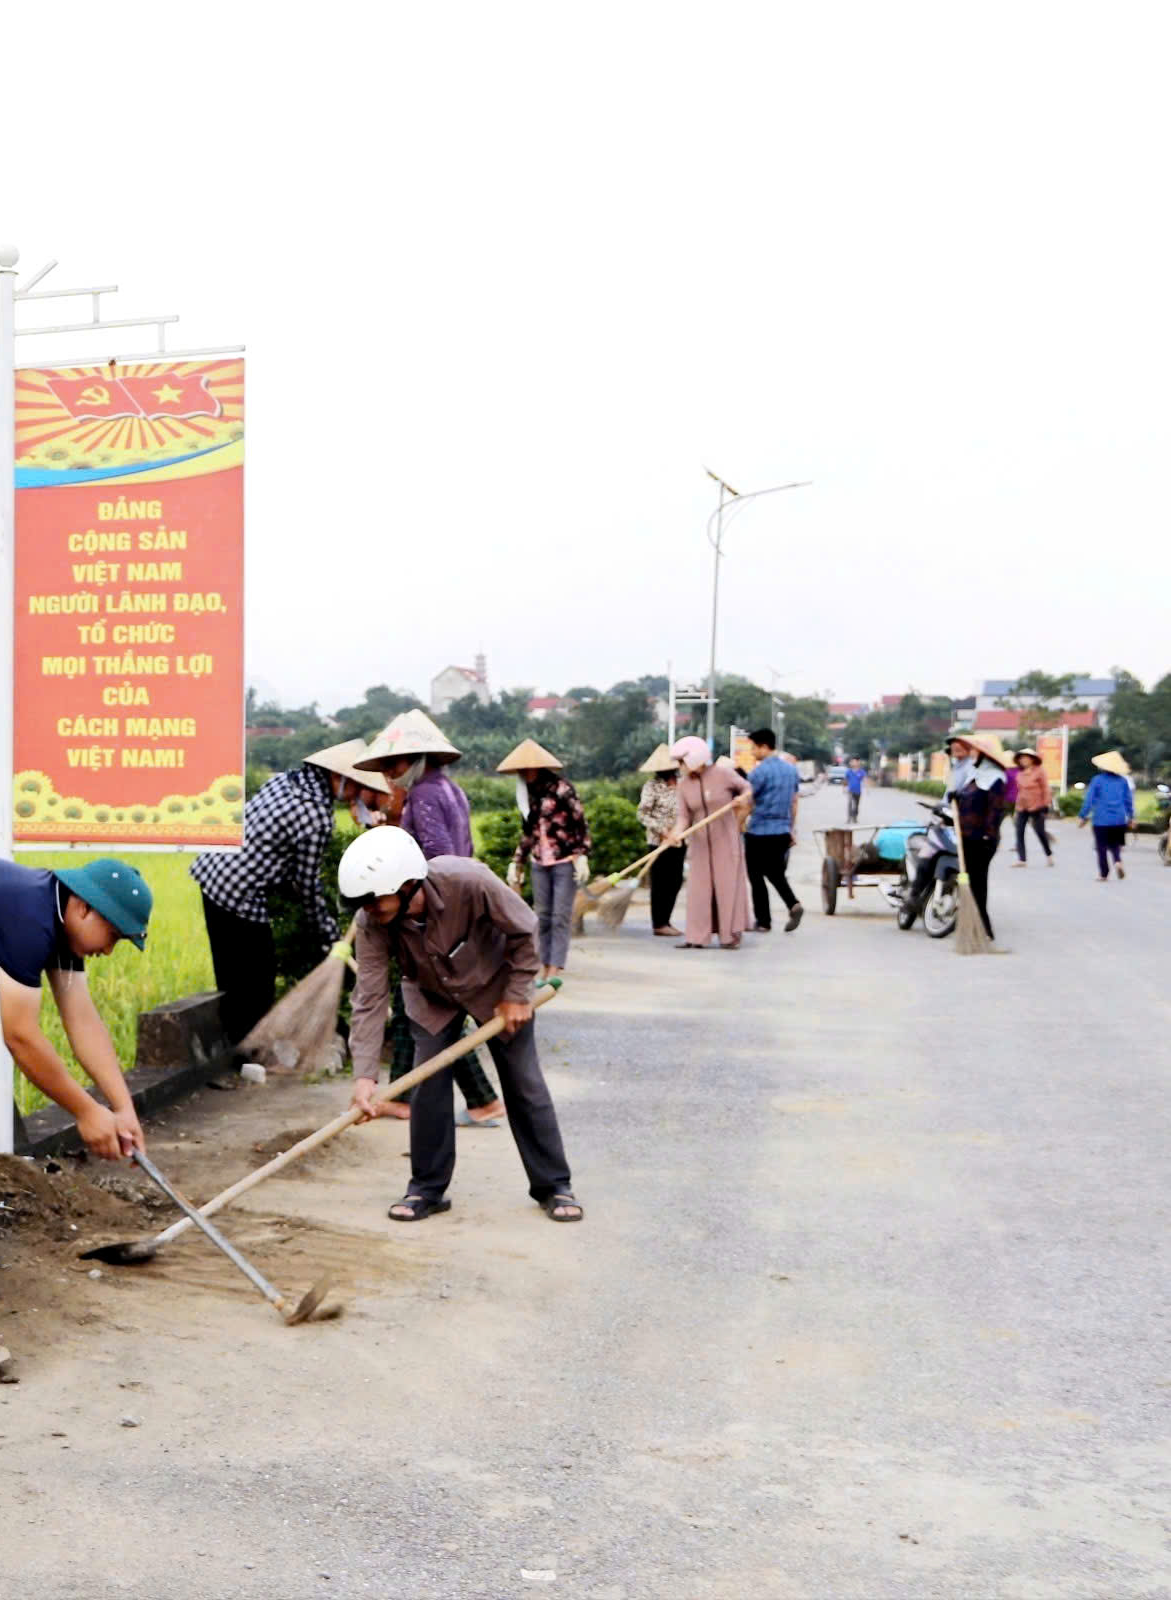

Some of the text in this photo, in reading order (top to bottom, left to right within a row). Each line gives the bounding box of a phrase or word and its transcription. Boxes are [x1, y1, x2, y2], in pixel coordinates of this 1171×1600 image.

[98, 496, 162, 520] ĐẢNG
[68, 525, 187, 556] CỘNG SẢN
[72, 560, 182, 586] VIỆT NAM
[29, 589, 227, 615] NGƯỜI LÃNH ĐẠO,
[78, 618, 175, 644] TỔ CHỨC
[42, 649, 213, 679] MỌI THẮNG LỢI
[102, 681, 150, 706] CỦA
[57, 714, 196, 740] CÁCH MẠNG
[66, 744, 185, 771] VIỆT NAM!
